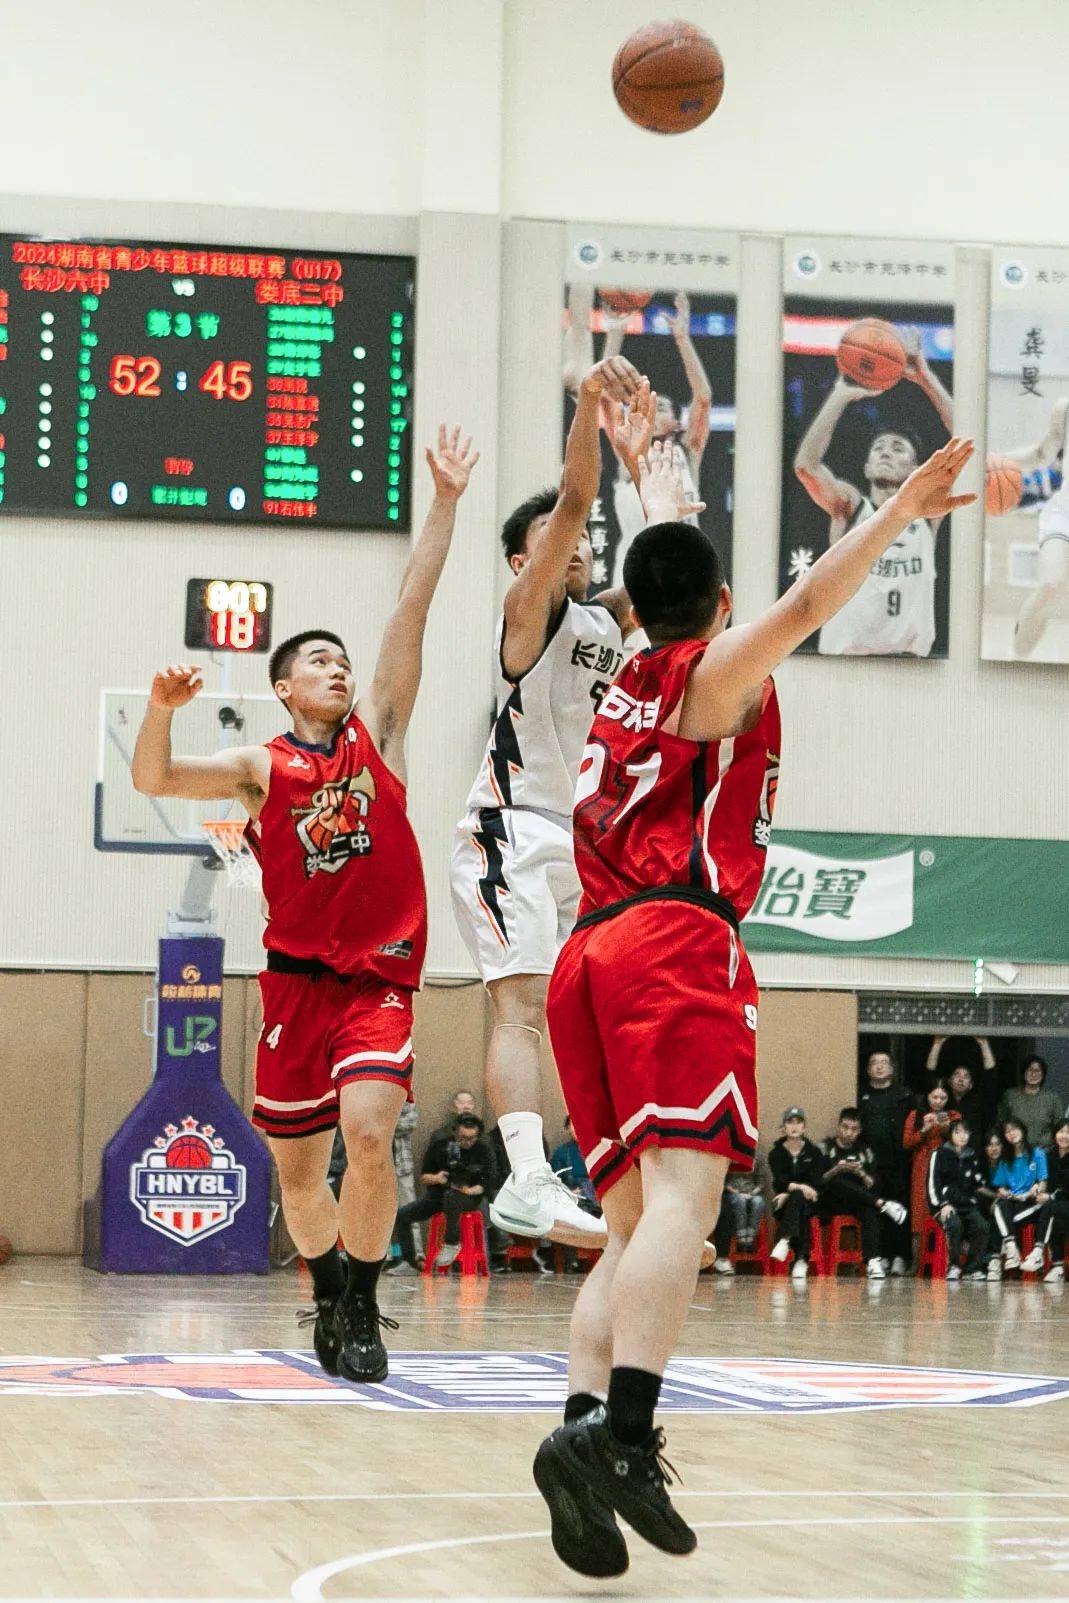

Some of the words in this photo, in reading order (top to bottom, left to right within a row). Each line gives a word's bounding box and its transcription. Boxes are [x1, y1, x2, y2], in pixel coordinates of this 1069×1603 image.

[20, 266, 109, 294] 长沙六中
[256, 280, 343, 307] 娄底二中
[110, 354, 161, 396] 52
[199, 360, 252, 400] 45
[887, 589, 901, 617] 9
[215, 611, 254, 648] 18
[266, 1024, 283, 1049] 4
[147, 1173, 233, 1194] HNYBL
